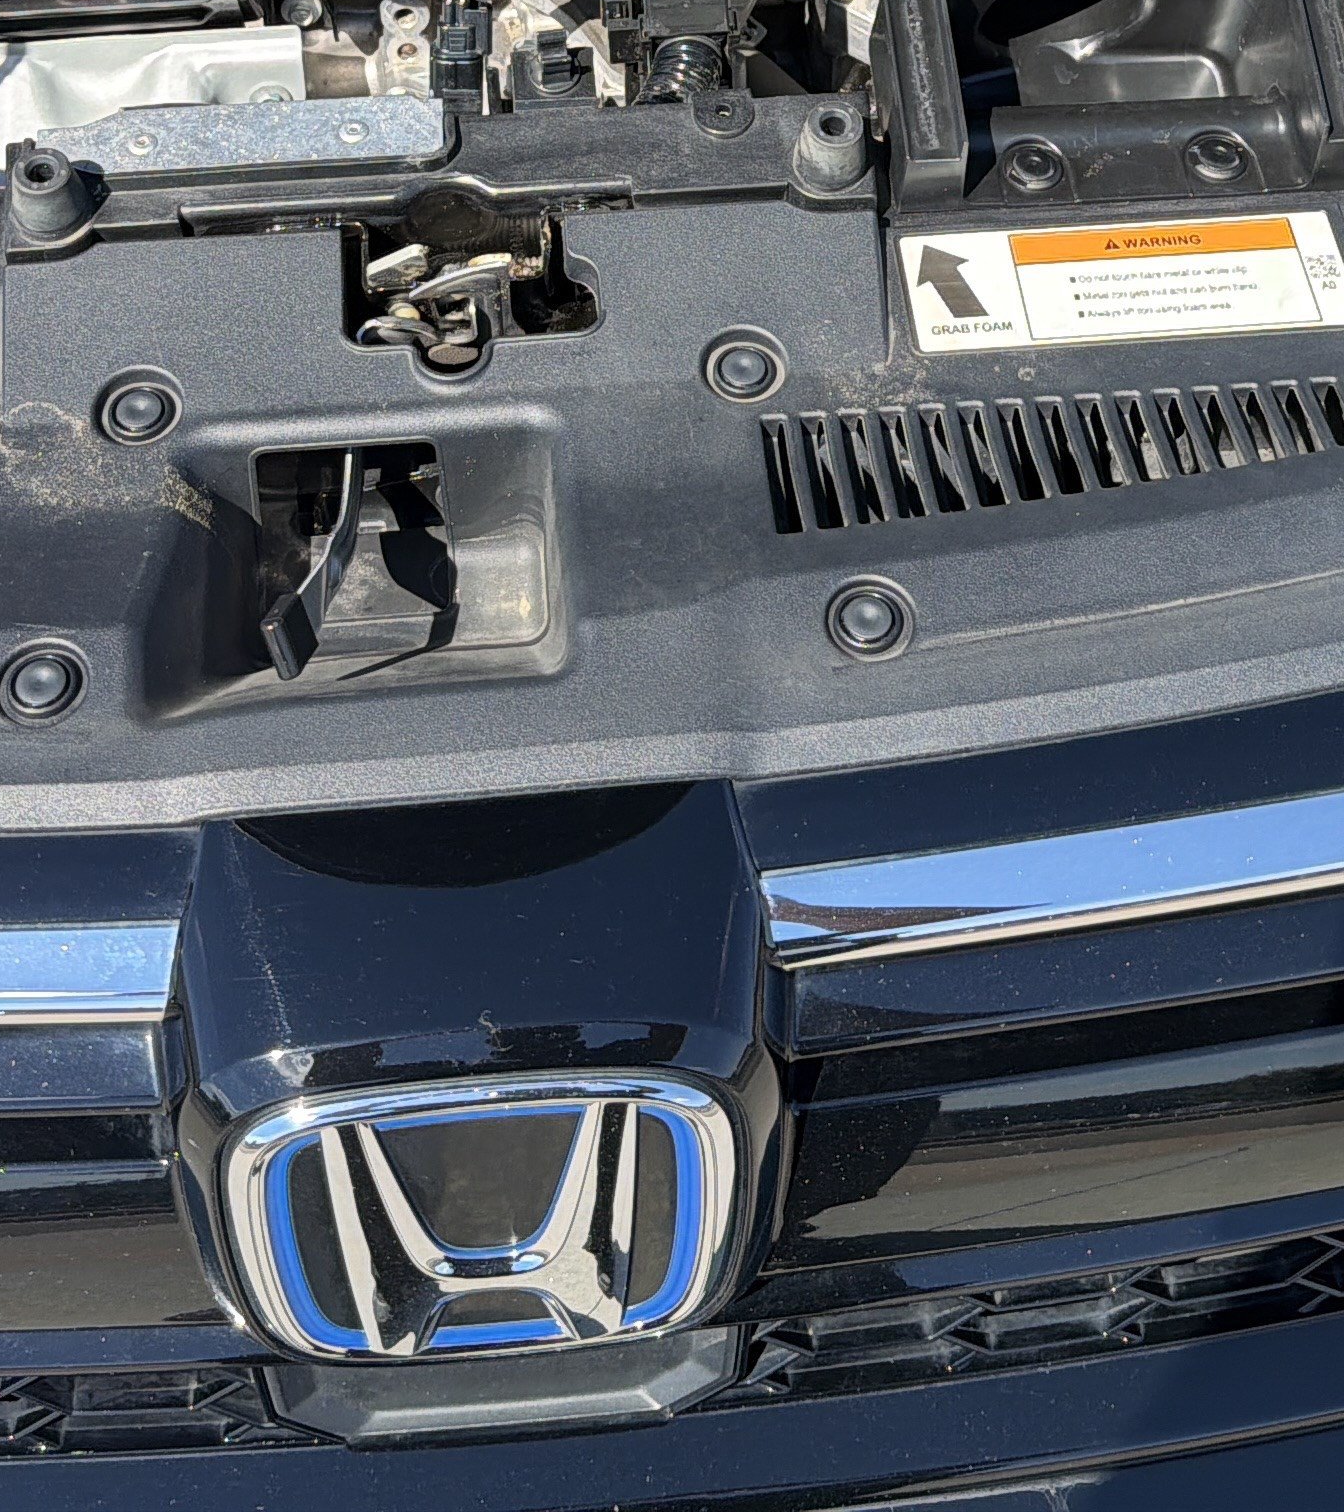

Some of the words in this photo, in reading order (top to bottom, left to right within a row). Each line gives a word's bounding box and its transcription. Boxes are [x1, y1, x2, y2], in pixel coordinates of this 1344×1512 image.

[1123, 234, 1201, 250] WARNING
[931, 323, 971, 337] GRAB
[973, 320, 1014, 334] FOAM
